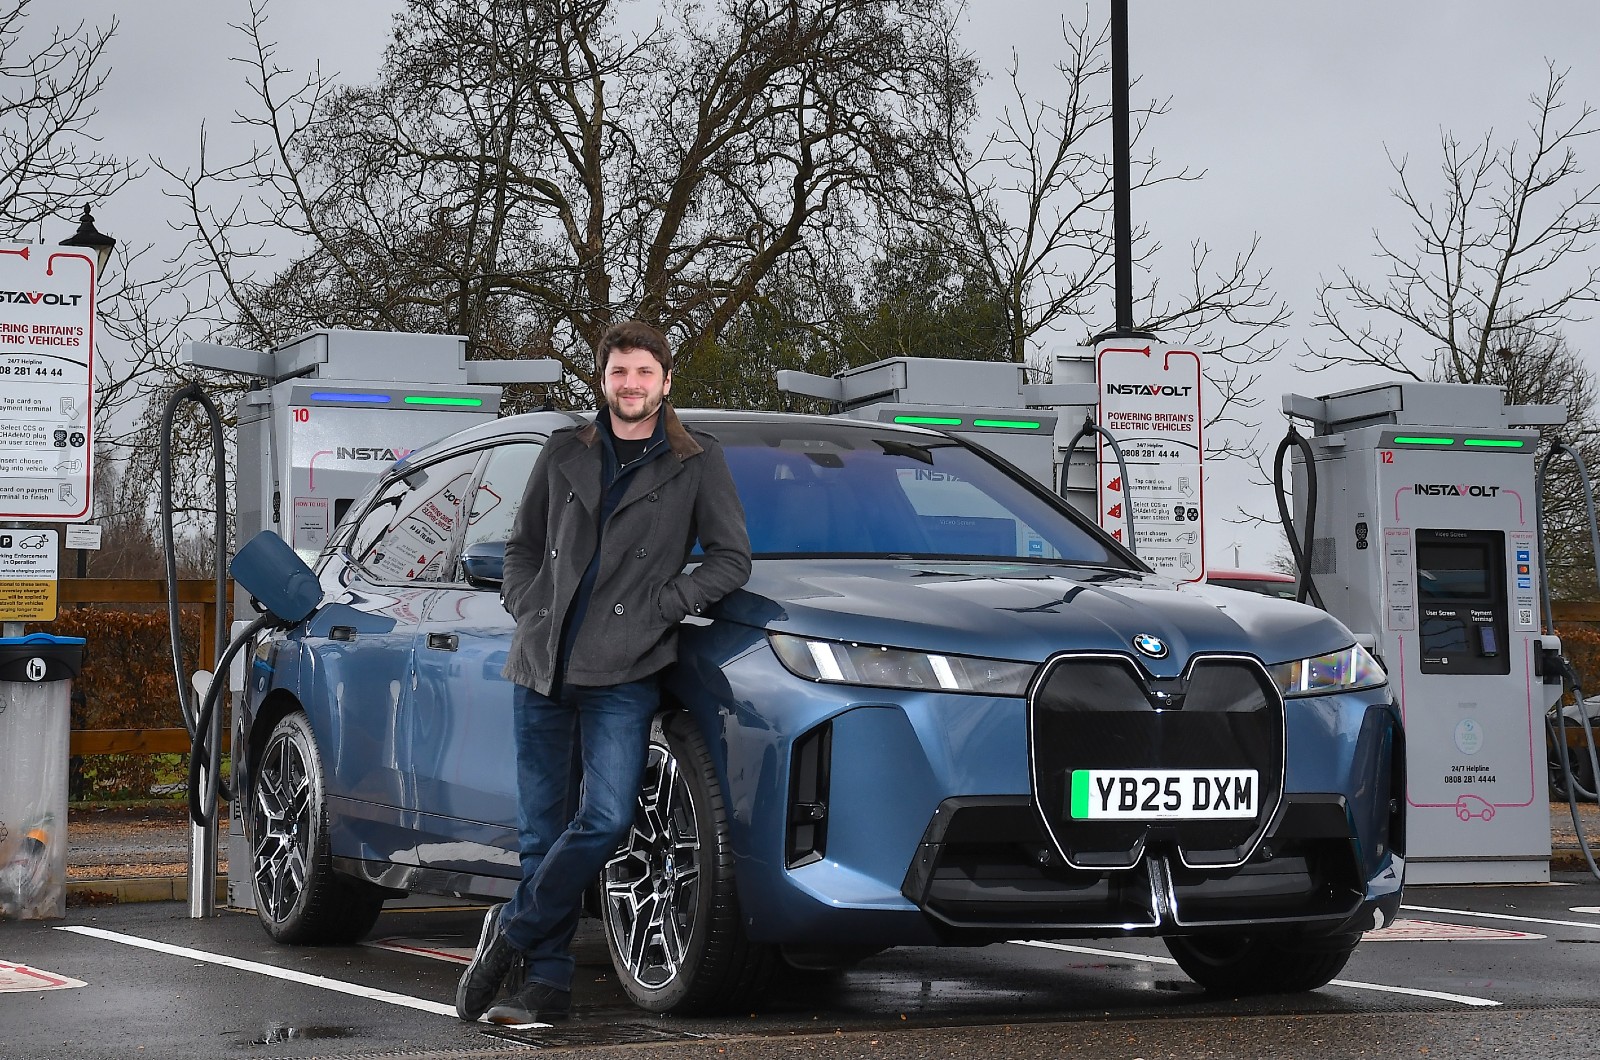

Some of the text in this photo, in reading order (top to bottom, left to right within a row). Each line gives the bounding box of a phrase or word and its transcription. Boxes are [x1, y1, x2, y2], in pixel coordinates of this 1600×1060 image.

[32, 325, 83, 336] BRITAIN'S
[0, 335, 80, 346] TRIC VEHICLES
[0, 366, 62, 376] 08 281 44 44
[1107, 384, 1192, 396] INSTAVOLT
[293, 408, 309, 422] 10
[1108, 412, 1194, 422] POWERING BRITAIN'S
[1111, 422, 1191, 432] ELECTRIC VEHICLES
[337, 447, 416, 461] INSTAV
[1381, 451, 1393, 464] 12
[1414, 484, 1499, 497] INSTAVOLT
[3, 537, 10, 546] P
[1096, 776, 1252, 811] YB25 DXM
